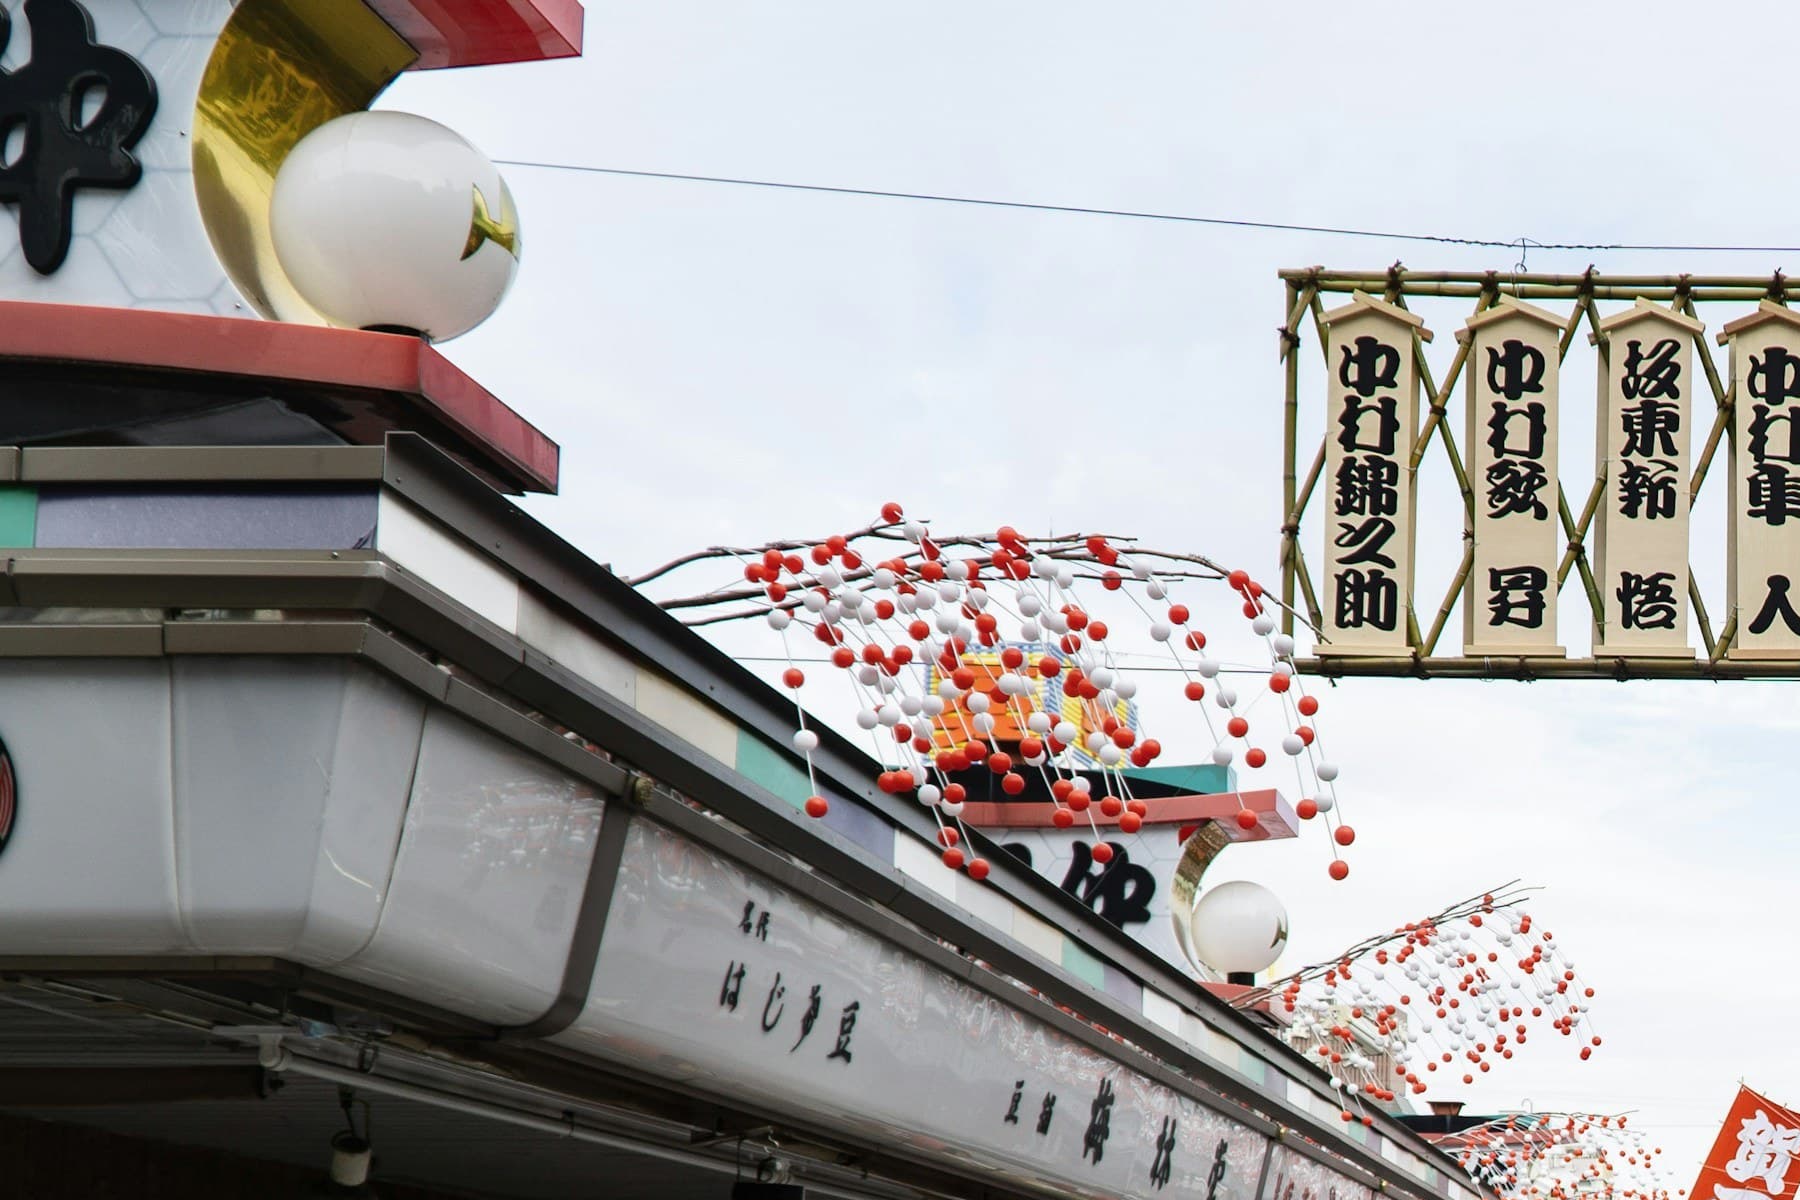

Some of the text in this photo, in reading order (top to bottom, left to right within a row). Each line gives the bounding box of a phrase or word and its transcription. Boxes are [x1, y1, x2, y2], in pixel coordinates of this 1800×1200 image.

[1335, 337, 1400, 631] 中村錦之助
[1617, 340, 1680, 629] 坂東新悟
